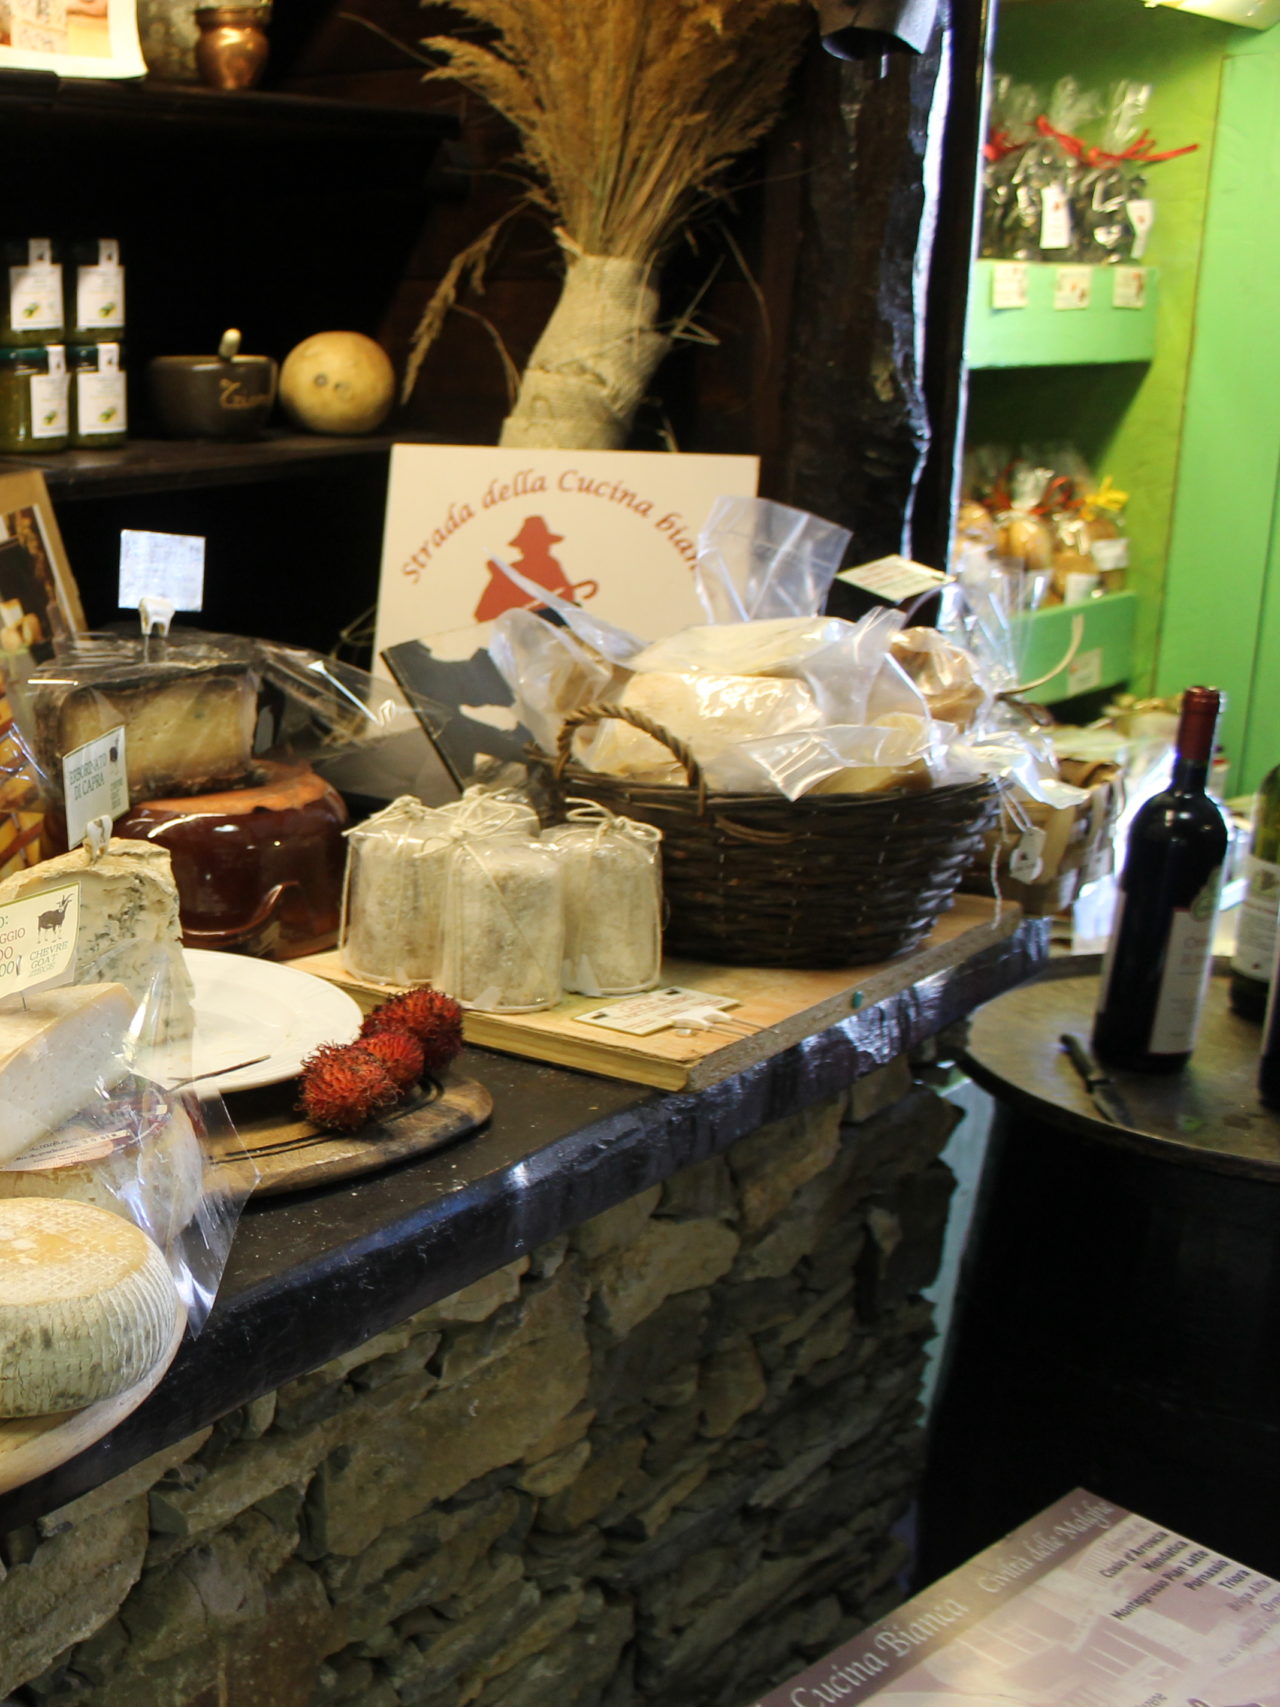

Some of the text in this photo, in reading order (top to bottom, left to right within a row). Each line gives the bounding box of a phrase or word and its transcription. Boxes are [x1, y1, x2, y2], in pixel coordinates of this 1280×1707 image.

[401, 468, 698, 585] Strada della Cucina bian
[29, 941, 69, 961] CHEVRE
[30, 954, 57, 970] GOAT
[1099, 1560, 1129, 1578] Cosio
[1141, 1540, 1189, 1571] Mendatica
[1110, 1550, 1210, 1621] Montegrosso Pian Latte
[1183, 1559, 1231, 1591] Pornassio
[1217, 1569, 1251, 1589] Triora
[790, 1651, 890, 1707] Cucina
[873, 1597, 969, 1658] Bianca
[1022, 1531, 1065, 1562] delle
